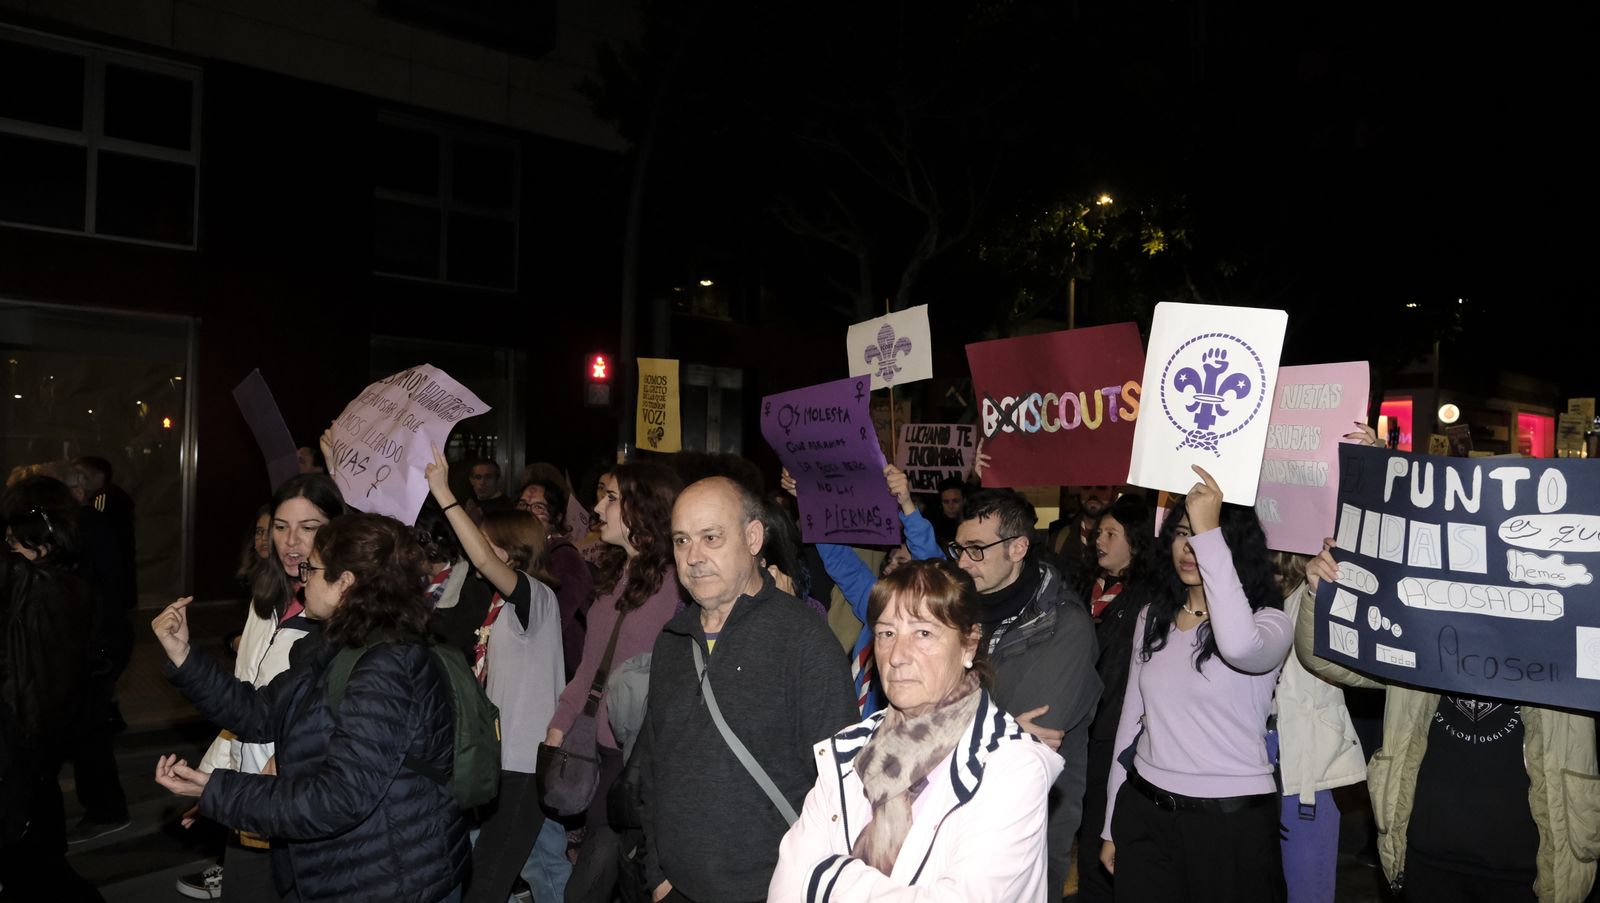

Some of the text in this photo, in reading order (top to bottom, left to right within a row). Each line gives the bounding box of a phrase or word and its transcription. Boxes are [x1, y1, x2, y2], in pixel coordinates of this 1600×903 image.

[643, 374, 668, 386] SOMOS
[1279, 383, 1344, 410] NIETAS
[401, 413, 424, 433] QUE
[642, 408, 666, 426] VOZ!
[803, 405, 852, 426] MOLESTA
[905, 426, 973, 447] LUCHANDO TE
[1266, 424, 1322, 451] BRUJAS
[332, 439, 370, 476] VIVAS
[841, 460, 867, 472] PERO
[817, 480, 855, 497] NO LAS
[1383, 456, 1568, 514] PUNTO
[824, 503, 883, 530] PIERNAS
[1549, 524, 1600, 549] qu
[1512, 549, 1567, 581] hemos
[1401, 577, 1563, 616] ACOSADAS
[1332, 624, 1359, 656] NO
